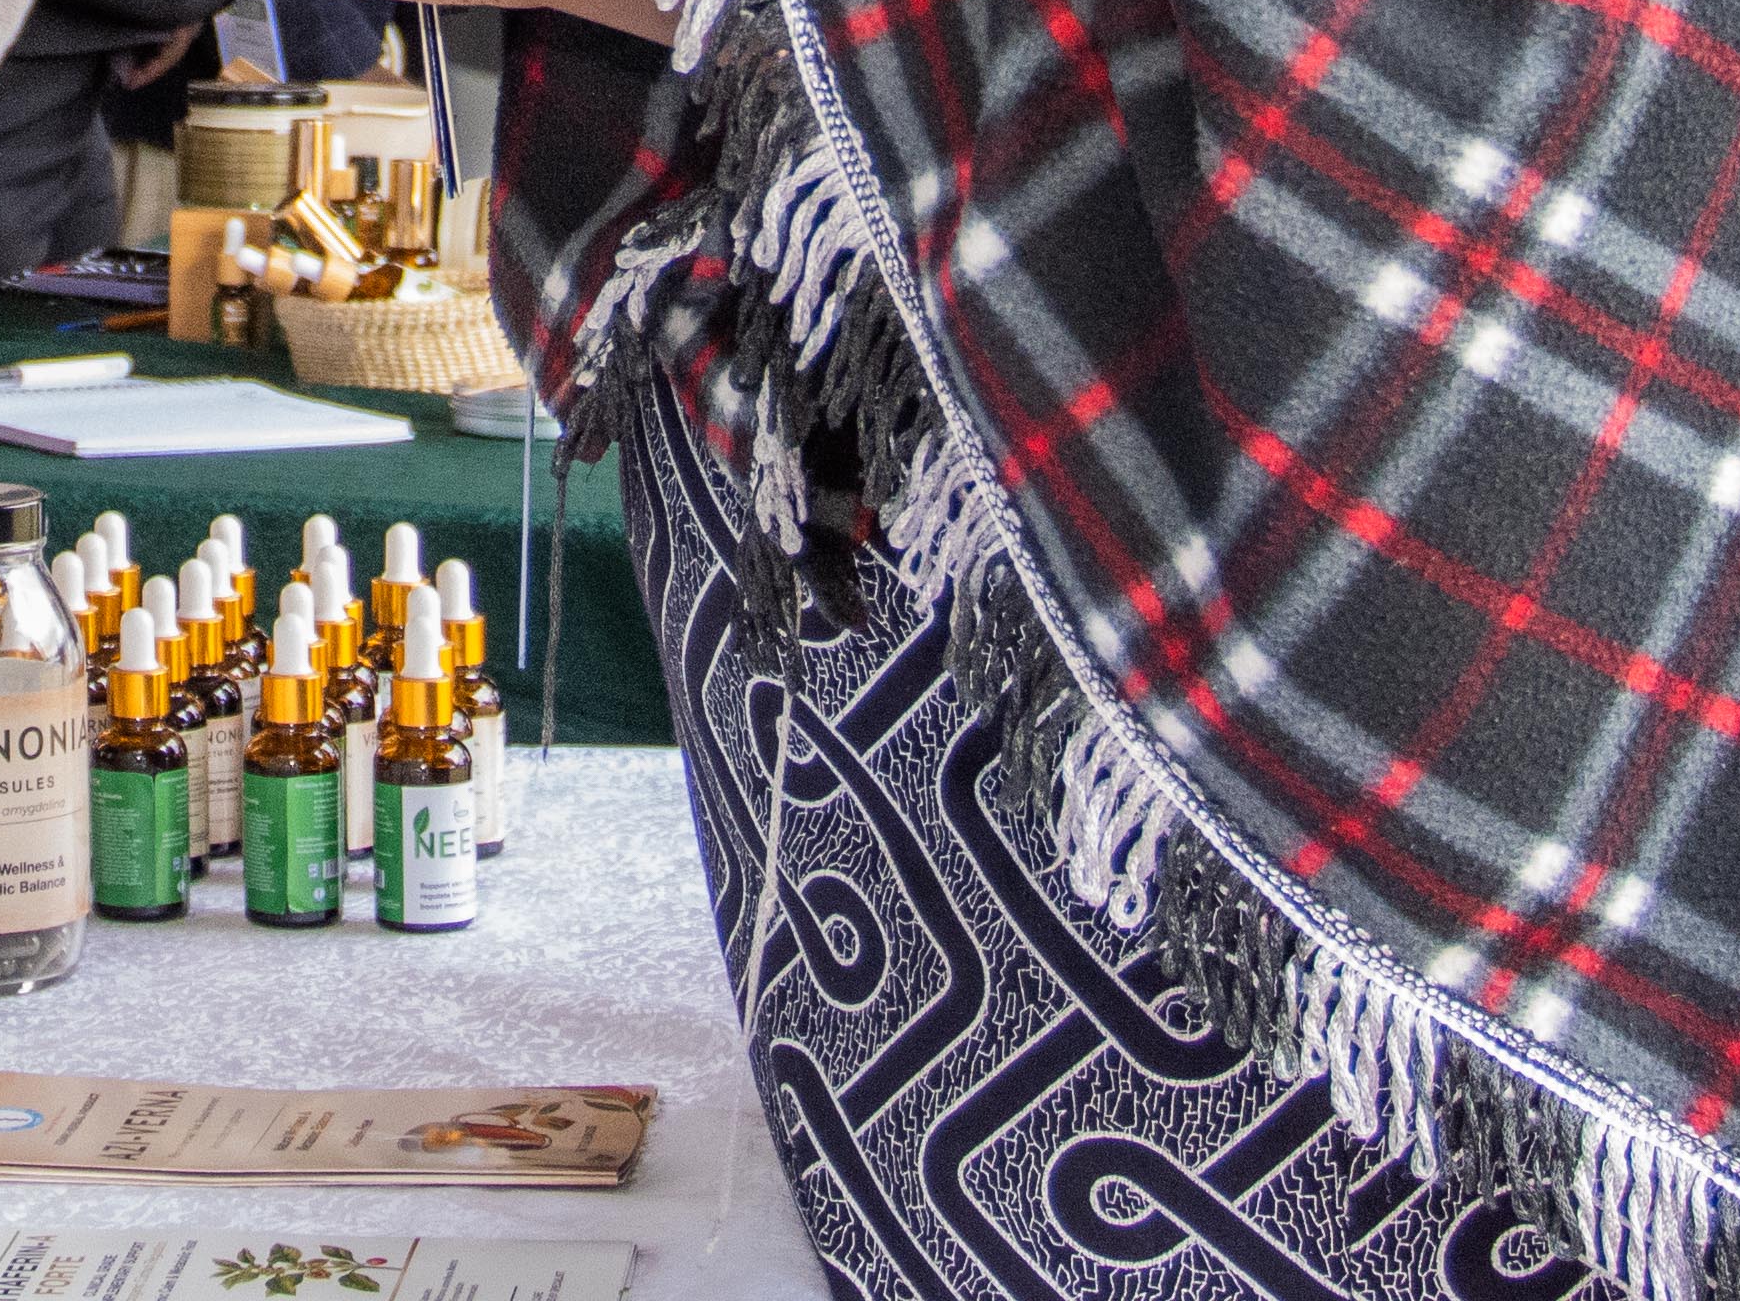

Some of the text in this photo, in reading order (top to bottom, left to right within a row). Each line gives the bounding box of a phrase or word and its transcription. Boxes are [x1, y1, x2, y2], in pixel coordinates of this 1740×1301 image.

[2, 798, 66, 818] amygdalina
[19, 875, 66, 895] Balance
[32, 1256, 84, 1295] FORTE
